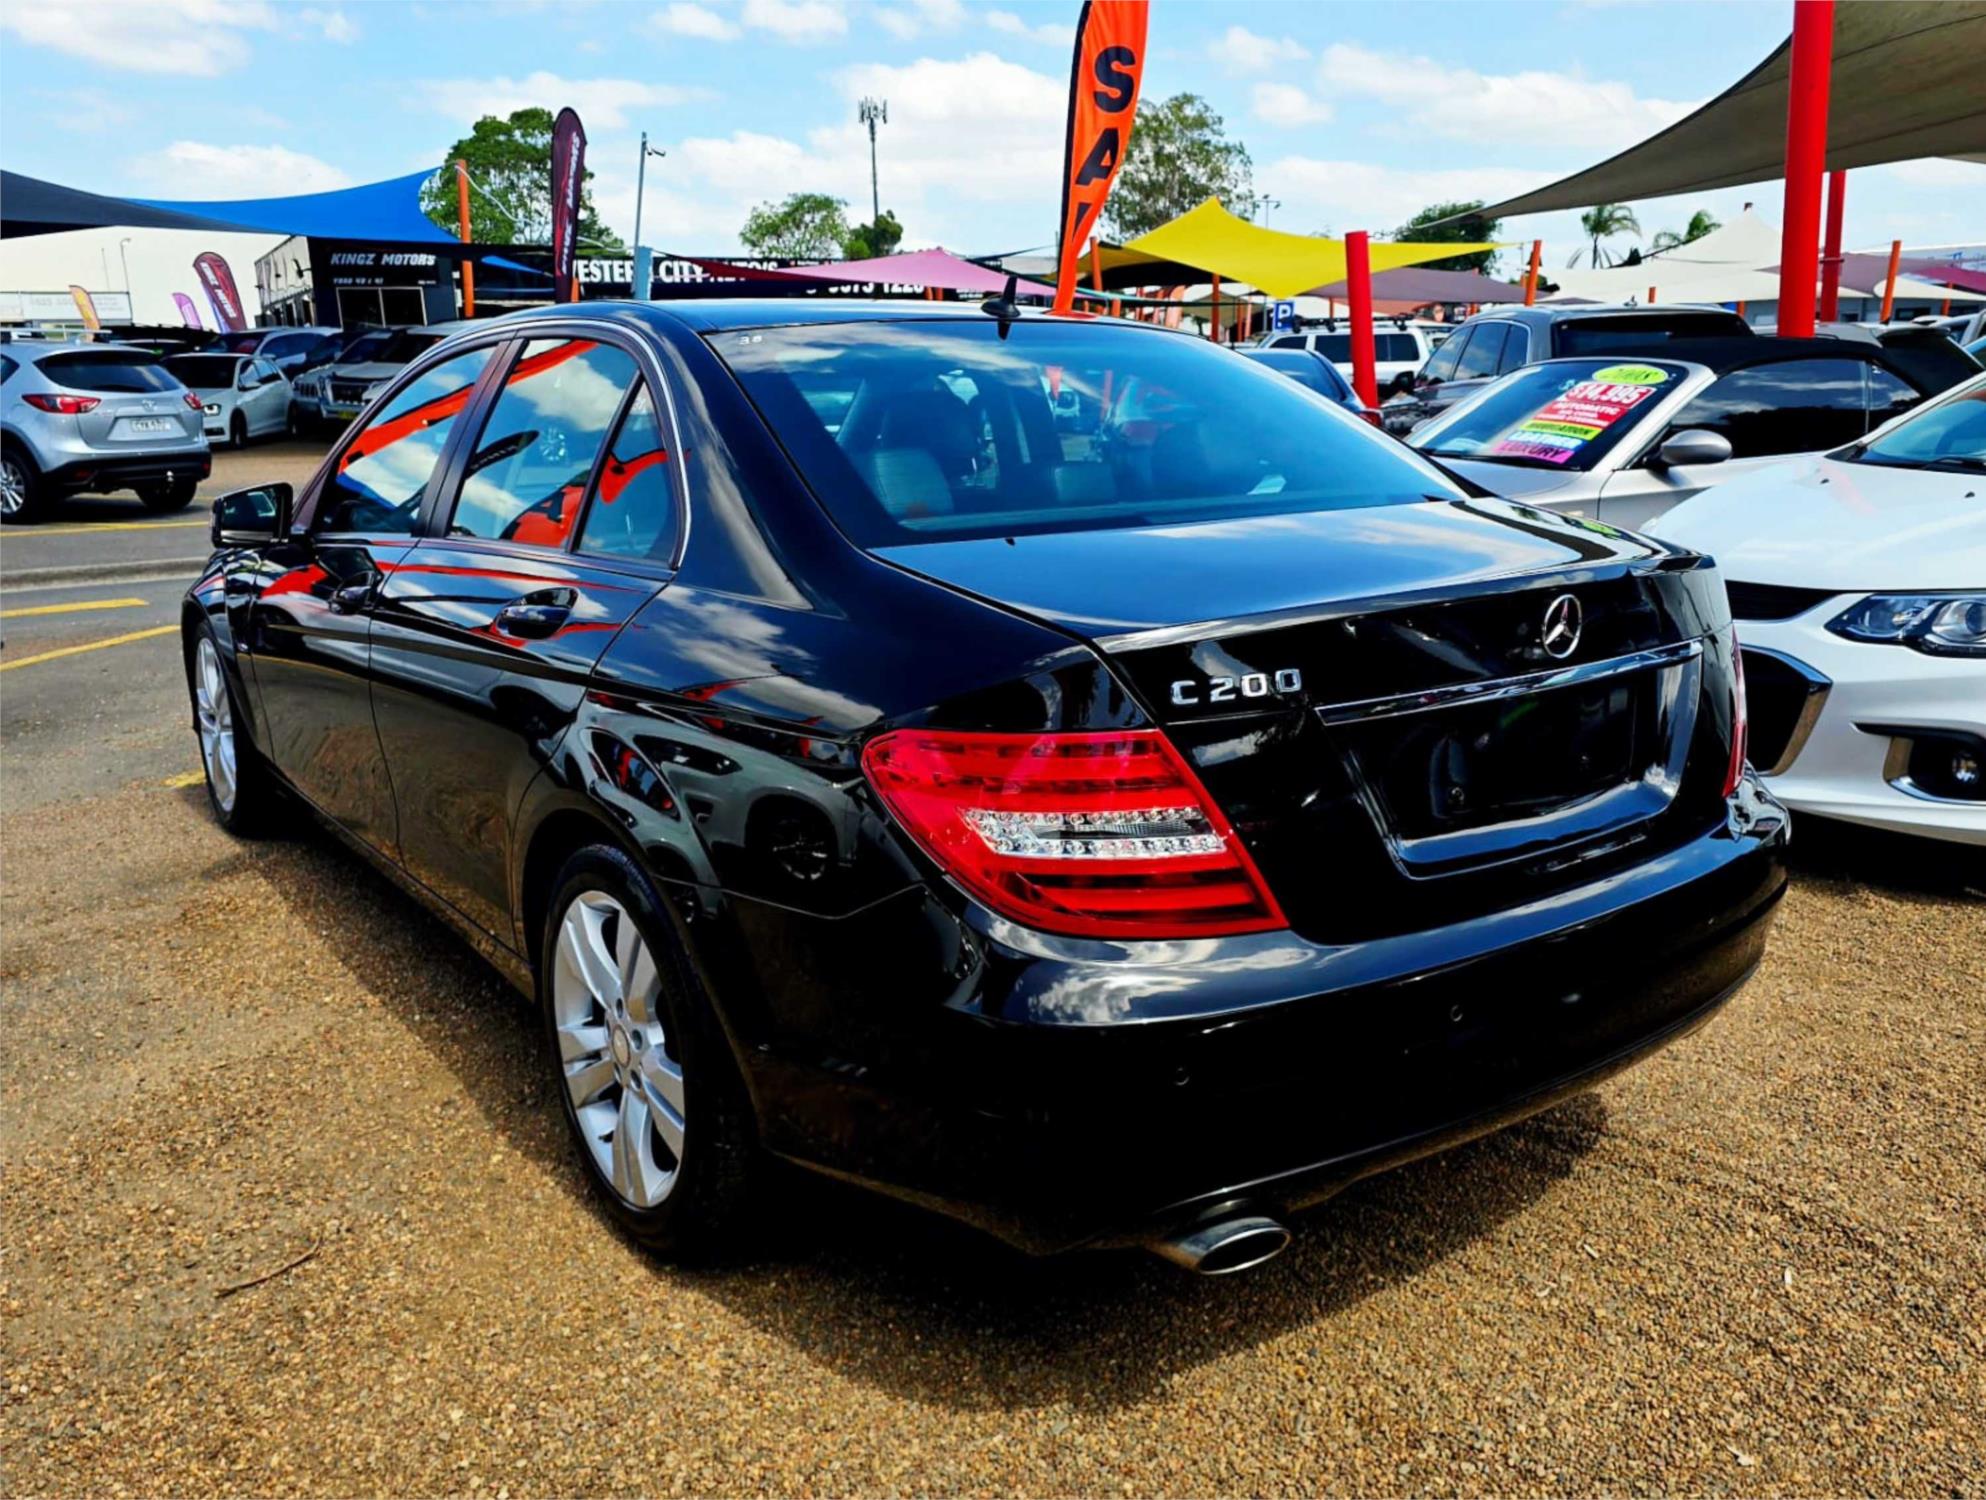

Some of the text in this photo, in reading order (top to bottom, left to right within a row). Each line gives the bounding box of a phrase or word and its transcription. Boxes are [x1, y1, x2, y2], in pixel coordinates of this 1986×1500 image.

[331, 253, 436, 265] KINGZ MOTORS
[1170, 668, 1302, 706] C 200
